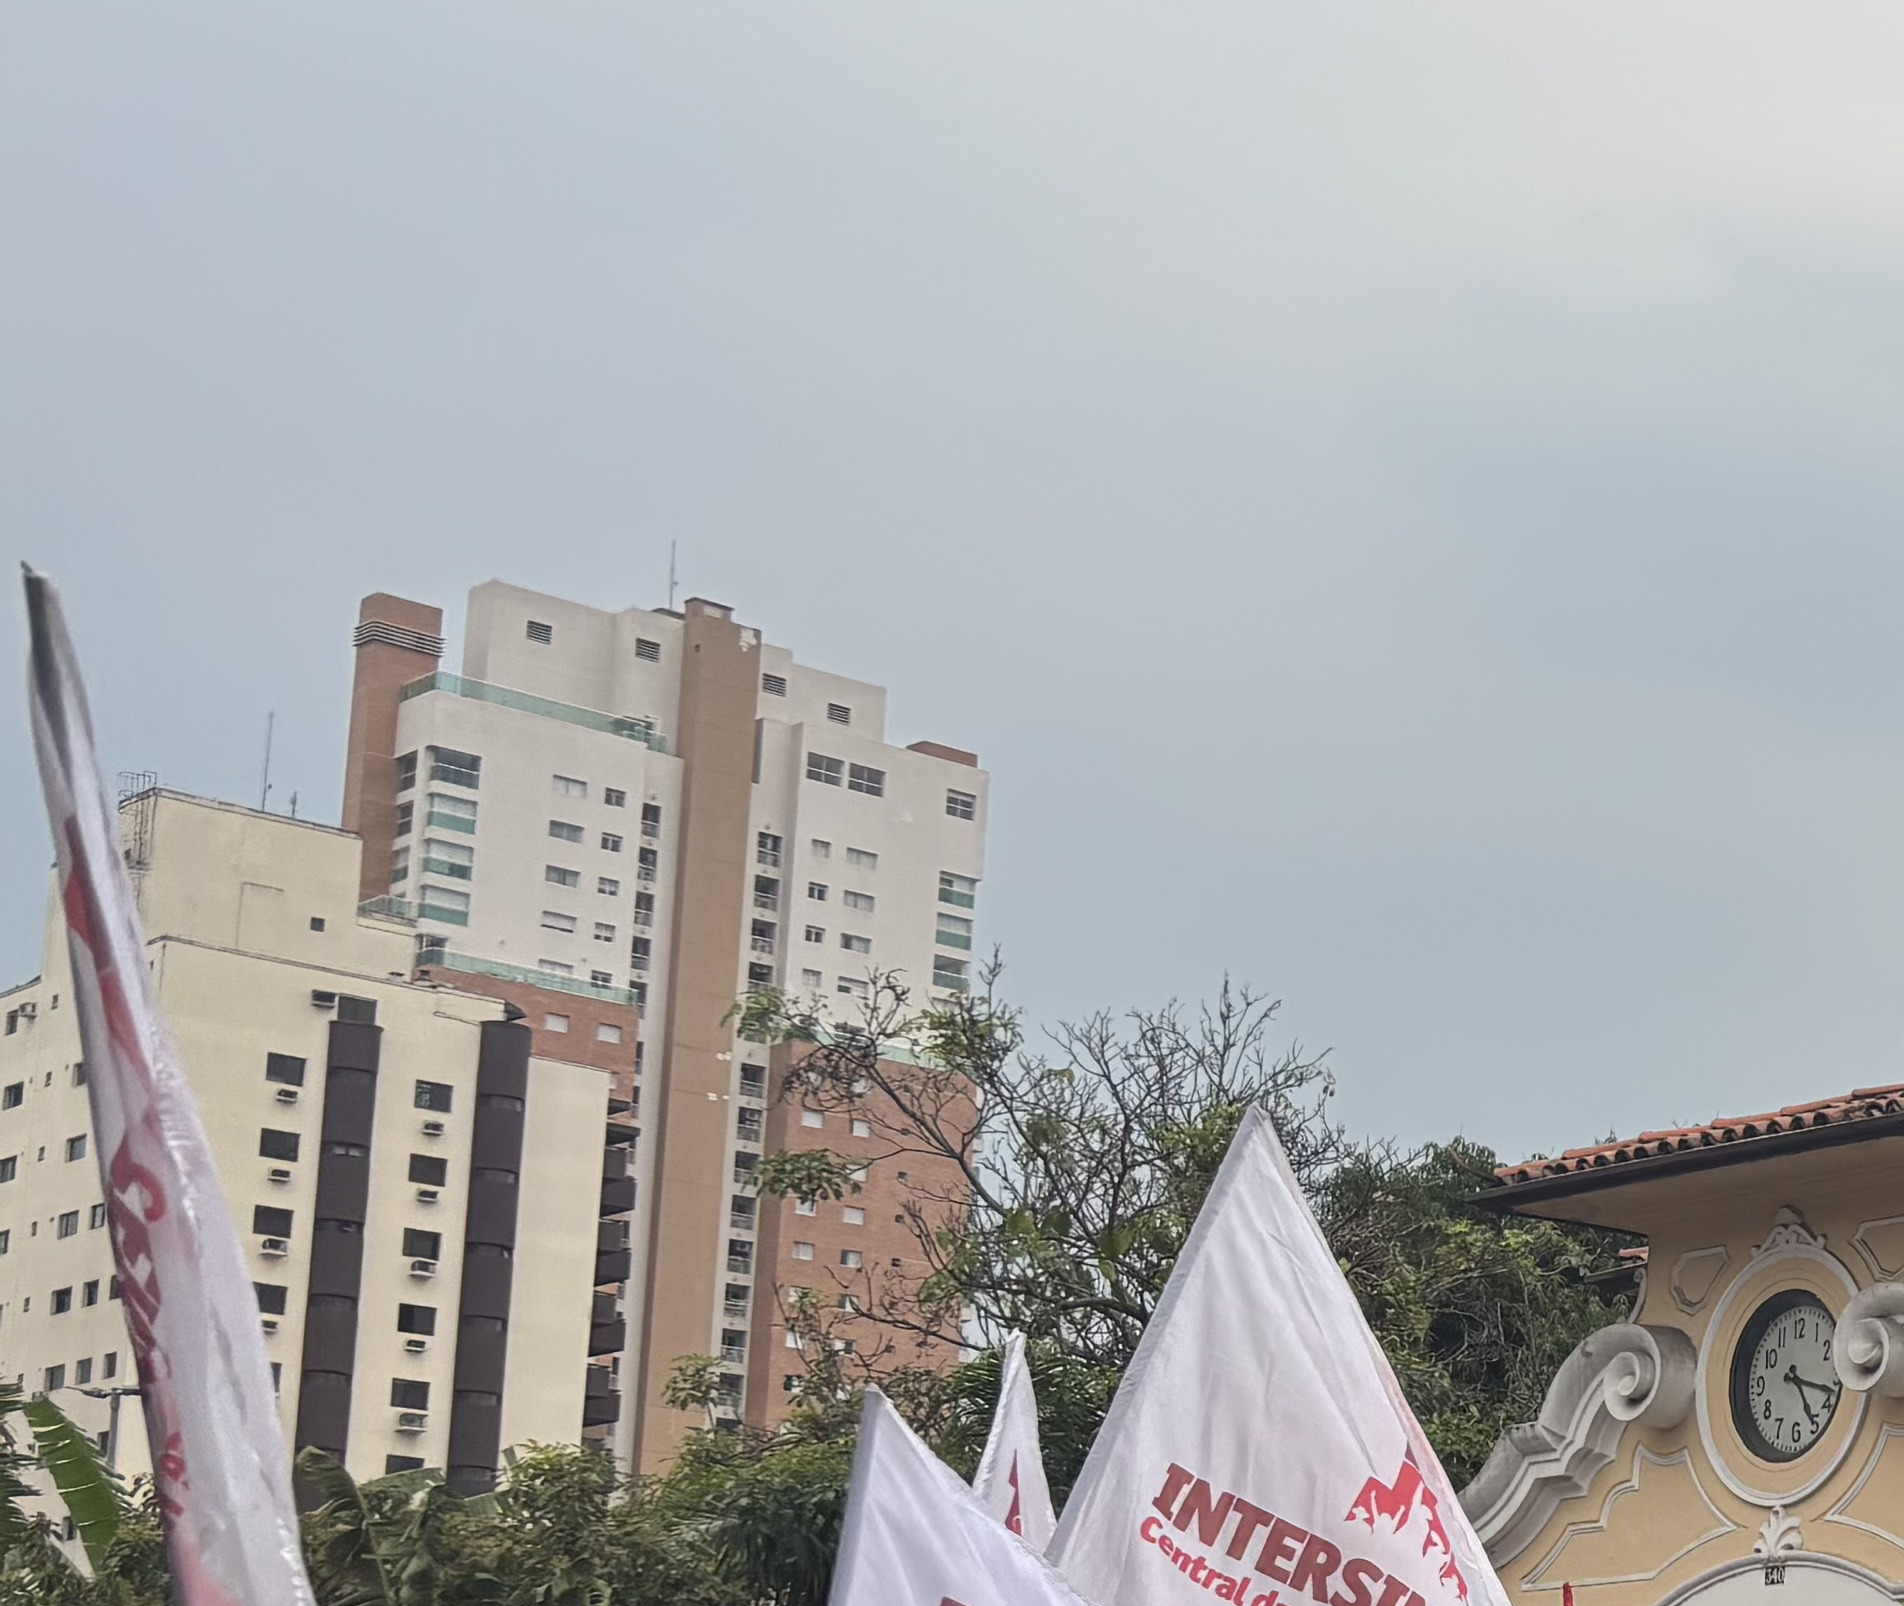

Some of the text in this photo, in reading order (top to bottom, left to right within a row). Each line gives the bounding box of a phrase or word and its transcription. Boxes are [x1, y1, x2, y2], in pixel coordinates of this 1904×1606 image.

[1778, 1327, 1786, 1348] 11
[1794, 1318, 1805, 1339] 12
[1815, 1322, 1819, 1342] 1
[1765, 1349, 1777, 1369] 10
[1823, 1340, 1831, 1361] 2
[1757, 1376, 1765, 1396] 9
[1763, 1399, 1772, 1419] 8
[1821, 1394, 1832, 1413] 4
[1775, 1418, 1784, 1439] 7
[1792, 1422, 1801, 1442] 6
[1810, 1414, 1819, 1435] 5
